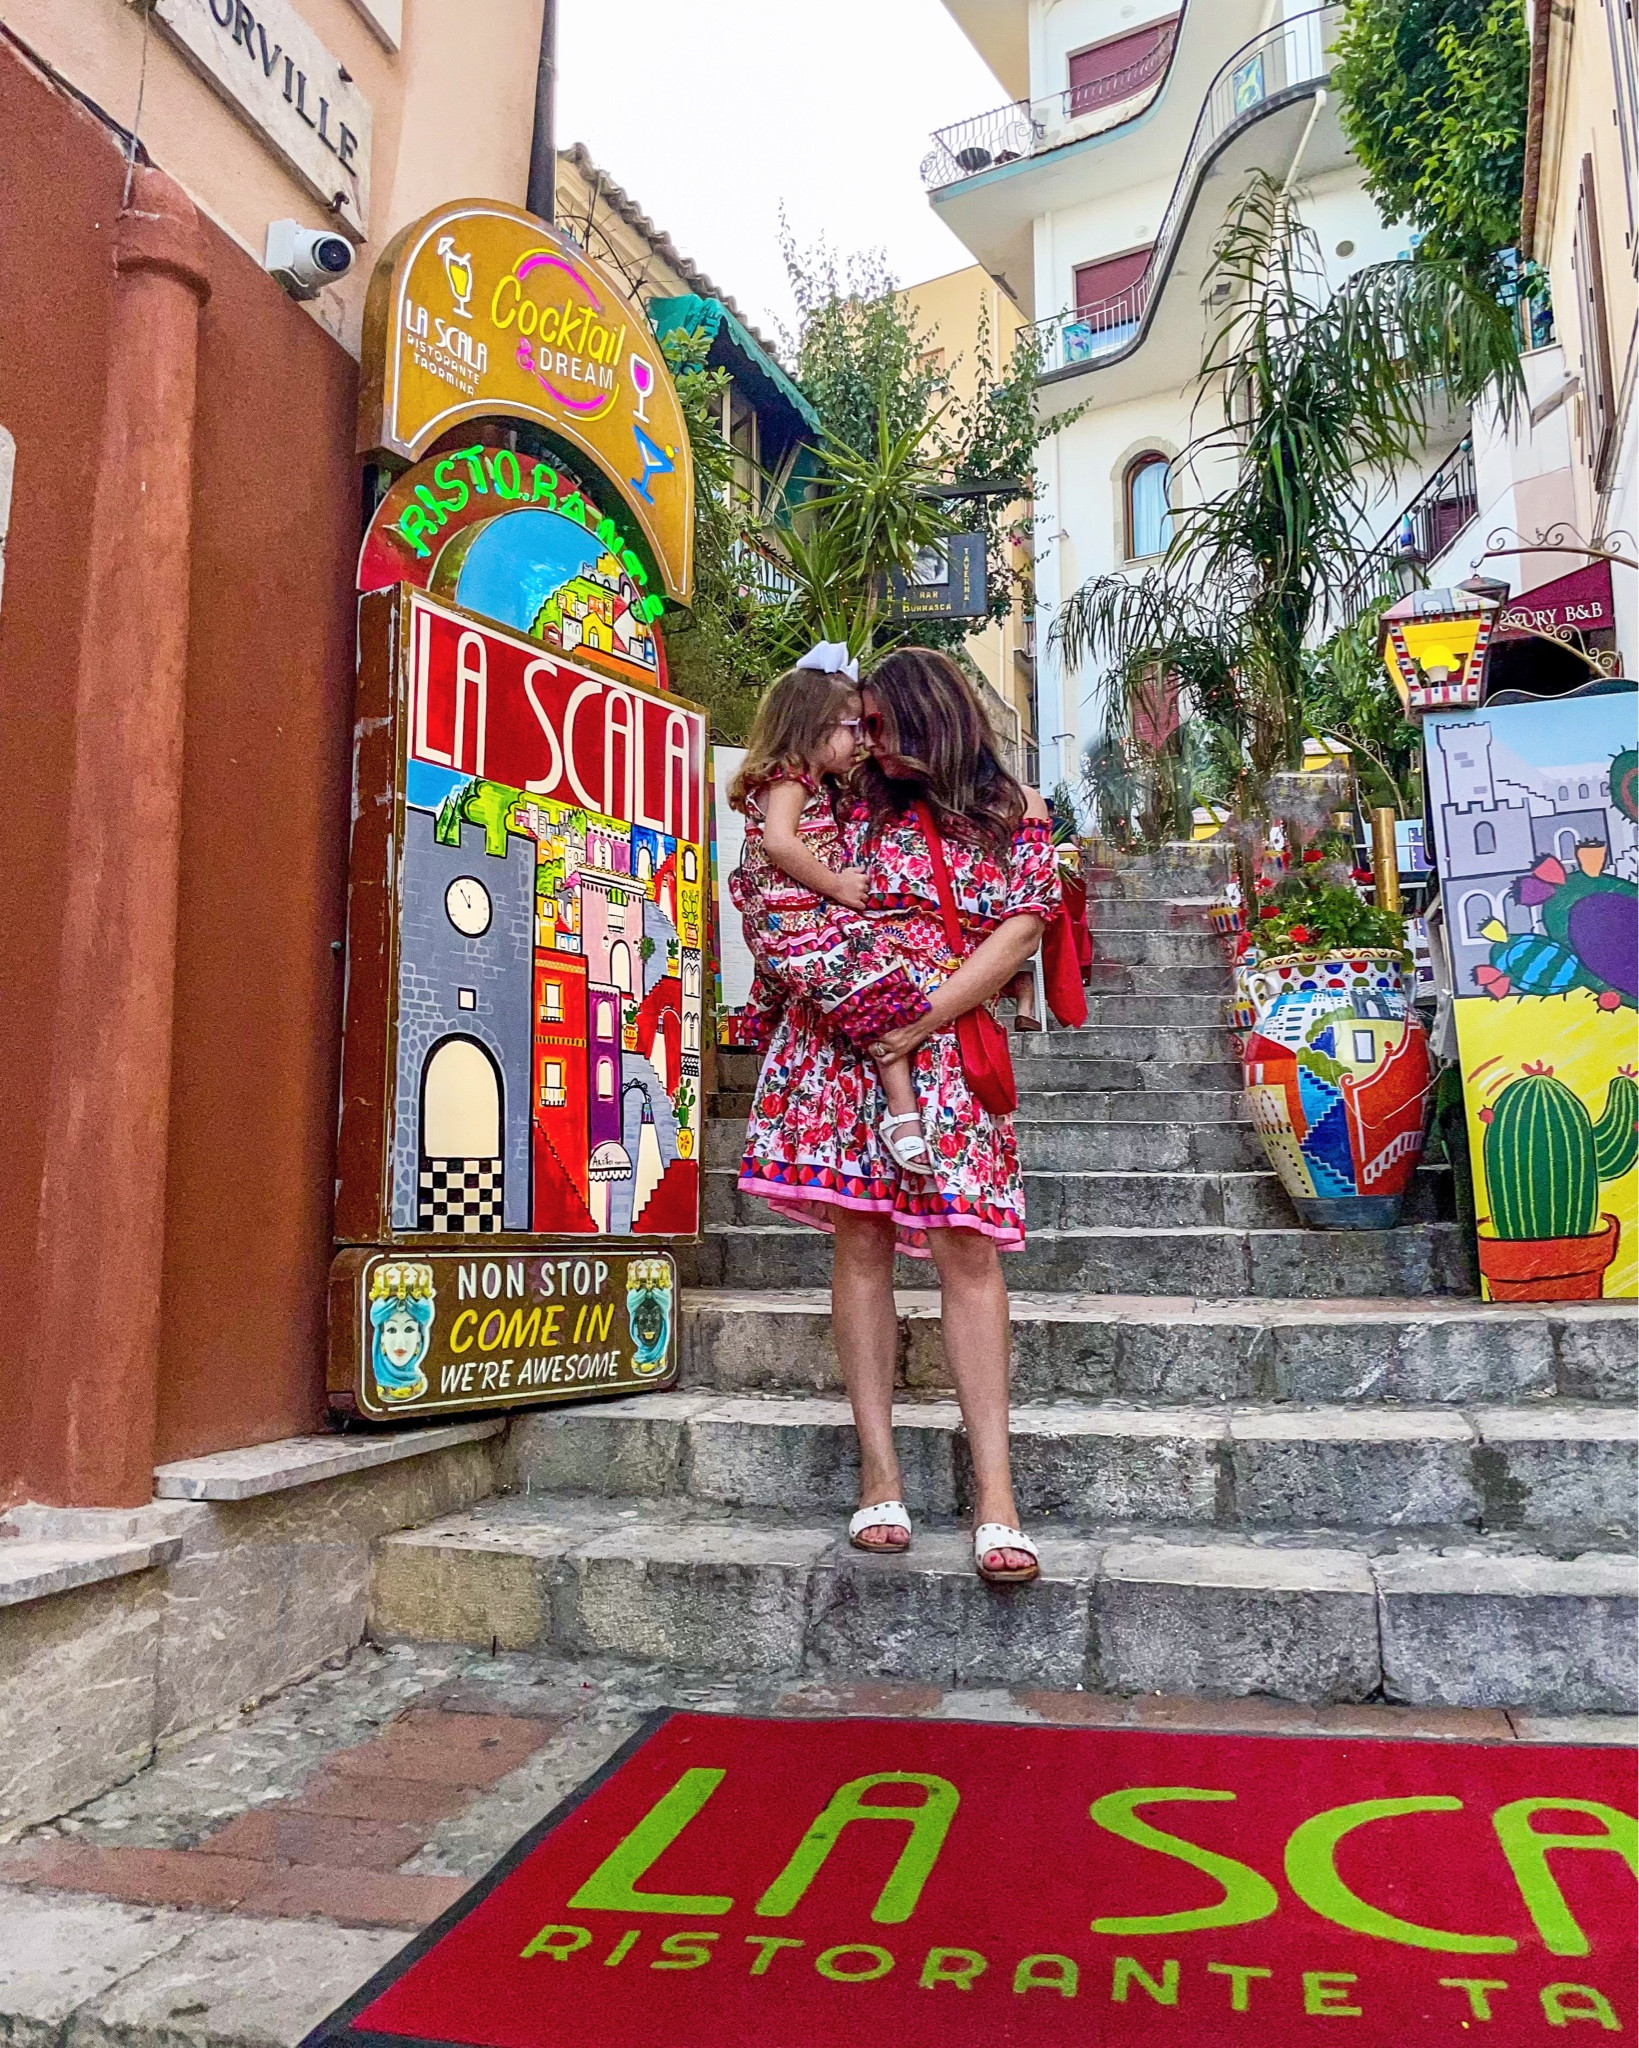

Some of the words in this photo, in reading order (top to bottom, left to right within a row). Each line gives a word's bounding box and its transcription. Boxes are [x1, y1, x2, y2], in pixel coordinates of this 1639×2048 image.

[405, 299, 429, 339] LA
[434, 318, 488, 374] SCALA
[406, 334, 480, 386] RISTORANTE
[413, 352, 475, 397] TAORMINA
[539, 347, 614, 391] DREAM
[399, 444, 664, 623] RISTORANTE
[962, 547, 970, 601] TAVERNA
[1565, 601, 1603, 622] B&B
[416, 611, 487, 777] LA
[523, 658, 690, 841] SCALA
[458, 1262, 525, 1300] NON
[539, 1260, 609, 1297] STOP
[450, 1304, 565, 1353] COME
[573, 1302, 615, 1344] IN
[441, 1359, 514, 1394] WE'RE
[517, 1350, 621, 1386] AWESOME
[567, 1767, 961, 1923] LA
[519, 1923, 1363, 2017] RISTORANTE
